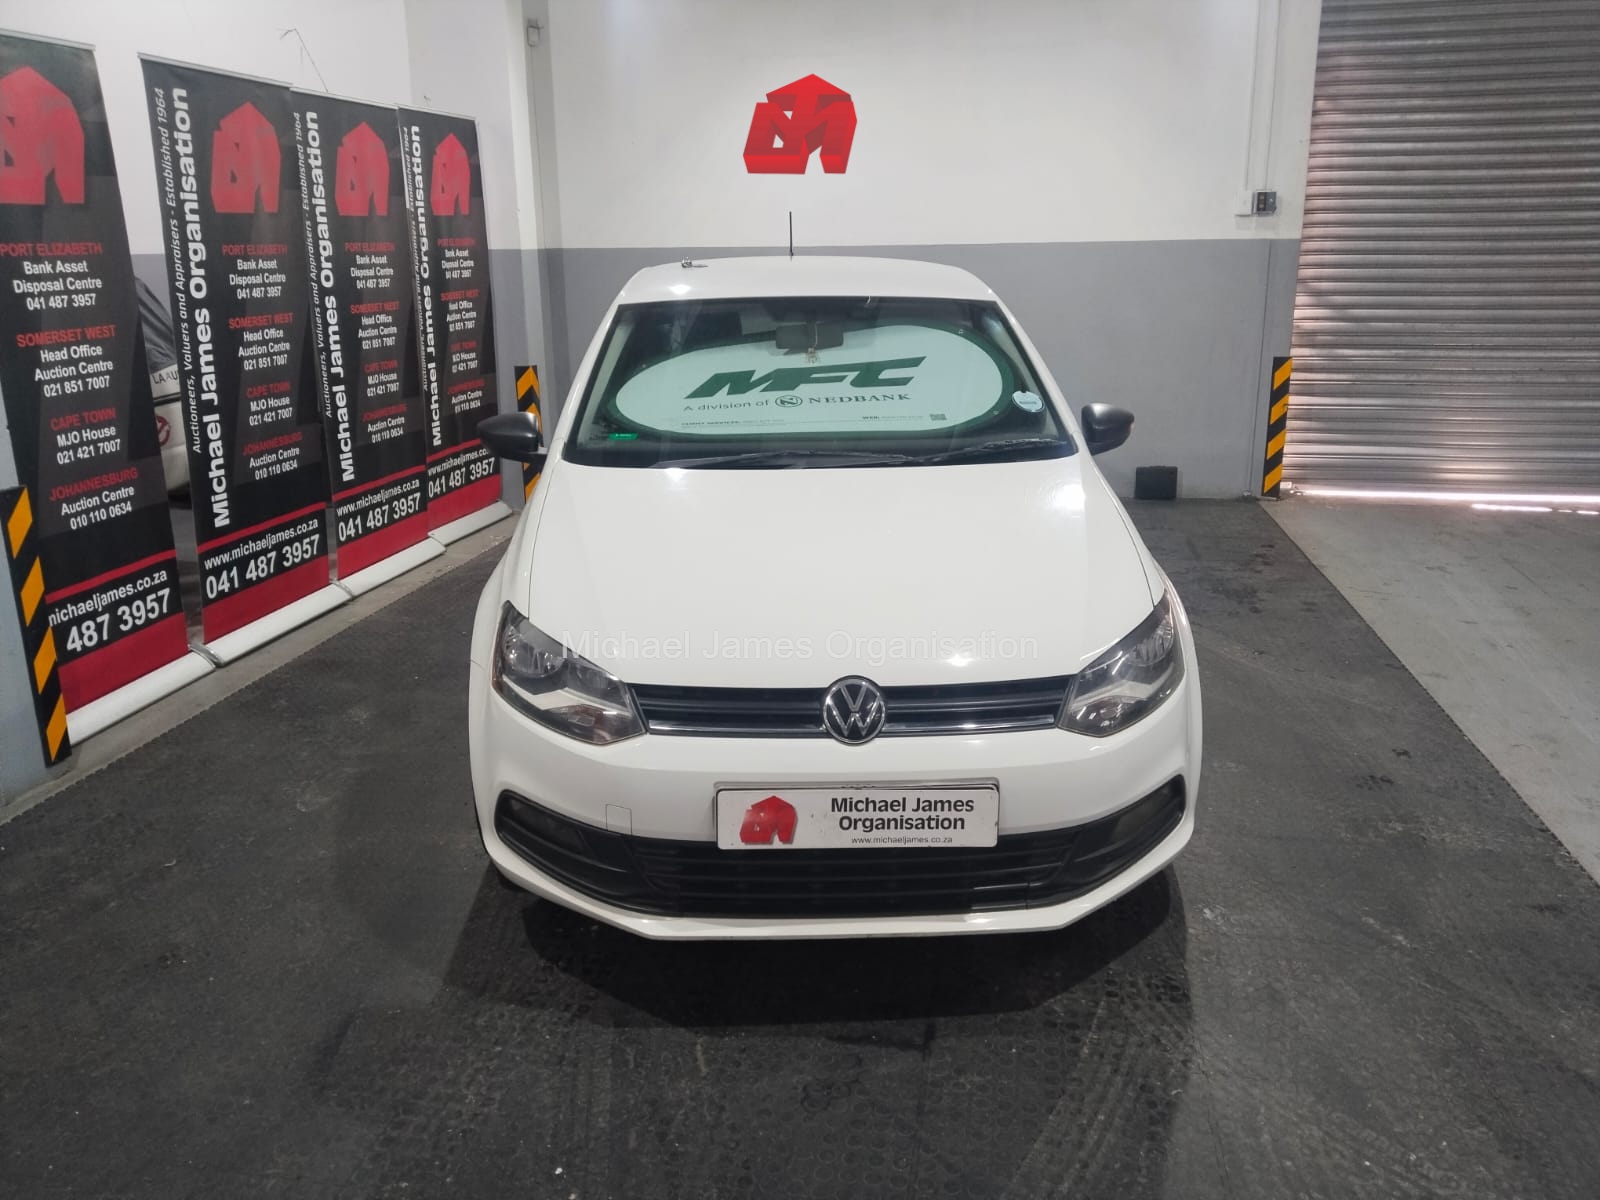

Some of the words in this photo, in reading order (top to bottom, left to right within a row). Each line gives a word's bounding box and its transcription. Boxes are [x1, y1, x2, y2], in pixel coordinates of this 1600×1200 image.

[154, 88, 168, 122] 1964
[158, 126, 176, 207] Established
[172, 88, 207, 299] organisation
[306, 112, 334, 288] organisation
[411, 126, 429, 279] organisation
[0, 242, 33, 256] PORT
[36, 242, 102, 255] ELIZABETH
[170, 219, 185, 290] Appraisers
[24, 260, 53, 274] Bank
[56, 260, 88, 272] Asset
[237, 259, 256, 270] Bank
[258, 259, 277, 269] Asset
[13, 278, 64, 294] Disposal
[66, 277, 102, 290] Centre
[230, 274, 262, 286] Disposal
[264, 273, 286, 283] Centre
[26, 297, 46, 310] 041
[49, 296, 68, 309] 487
[73, 294, 96, 307] 3957
[237, 288, 250, 299] 041
[252, 288, 264, 298] 487
[267, 286, 281, 297] 3957
[311, 282, 320, 304] and
[176, 292, 188, 319] and
[424, 285, 435, 357] James
[16, 329, 81, 347] SOMERSET
[85, 325, 116, 338] WEST
[181, 322, 192, 370] Valuers
[244, 330, 262, 342] Head
[264, 328, 283, 339] Office
[325, 296, 344, 378] James
[40, 348, 68, 362] Head
[70, 345, 102, 358] Office
[194, 308, 218, 406] James
[238, 345, 267, 357] Auction
[269, 342, 290, 353] Centre
[34, 366, 76, 381] Auction
[79, 361, 113, 374] Centre
[244, 359, 256, 370] 021
[259, 357, 271, 368] 851
[44, 382, 62, 397] 021
[64, 380, 83, 394] 851
[86, 376, 110, 390] 7007
[684, 356, 926, 399] MFC
[187, 376, 201, 453] Auctioneers,
[251, 399, 266, 412] MJO
[268, 397, 290, 408] House
[428, 362, 441, 446] Michael
[698, 402, 751, 411] division
[809, 394, 910, 404] NEDBANK
[50, 414, 80, 430] CAPE
[82, 408, 116, 423] TOWN
[249, 414, 261, 426] 021
[264, 411, 275, 423] 421
[278, 408, 292, 419] 7007
[57, 431, 80, 447] MJO
[82, 427, 116, 441] House
[332, 385, 355, 482] Michael
[57, 449, 74, 464] 021
[77, 445, 95, 460] 421
[97, 439, 120, 455] 7007
[250, 454, 276, 468] Auction
[278, 448, 299, 460] Centre
[202, 414, 230, 528] Michael
[255, 468, 267, 480] 010
[269, 464, 280, 475] 110
[282, 460, 297, 472] 0634
[428, 475, 446, 498] 041
[449, 467, 466, 488] 487
[470, 457, 495, 480] 3957
[49, 467, 138, 501] JOHANNESBURG
[61, 496, 99, 515] Auction
[102, 486, 134, 502] Centre
[336, 479, 420, 517] www.michaeljames.co.za
[70, 514, 87, 530] 010
[89, 509, 106, 523] 110
[109, 501, 132, 518] 0634
[338, 515, 362, 542] 041
[367, 504, 389, 529] 487
[393, 492, 421, 519] 3957
[204, 518, 318, 570] www.michaeljames.co.za
[206, 566, 239, 599] 041
[246, 550, 276, 581] 487
[282, 534, 320, 567] 3957
[66, 613, 110, 652] 487
[117, 587, 170, 632] 3957
[831, 797, 906, 812] Michael
[912, 797, 974, 812] James
[839, 815, 965, 832] Organisation
[852, 836, 953, 845] www.michaeljames.co.za
